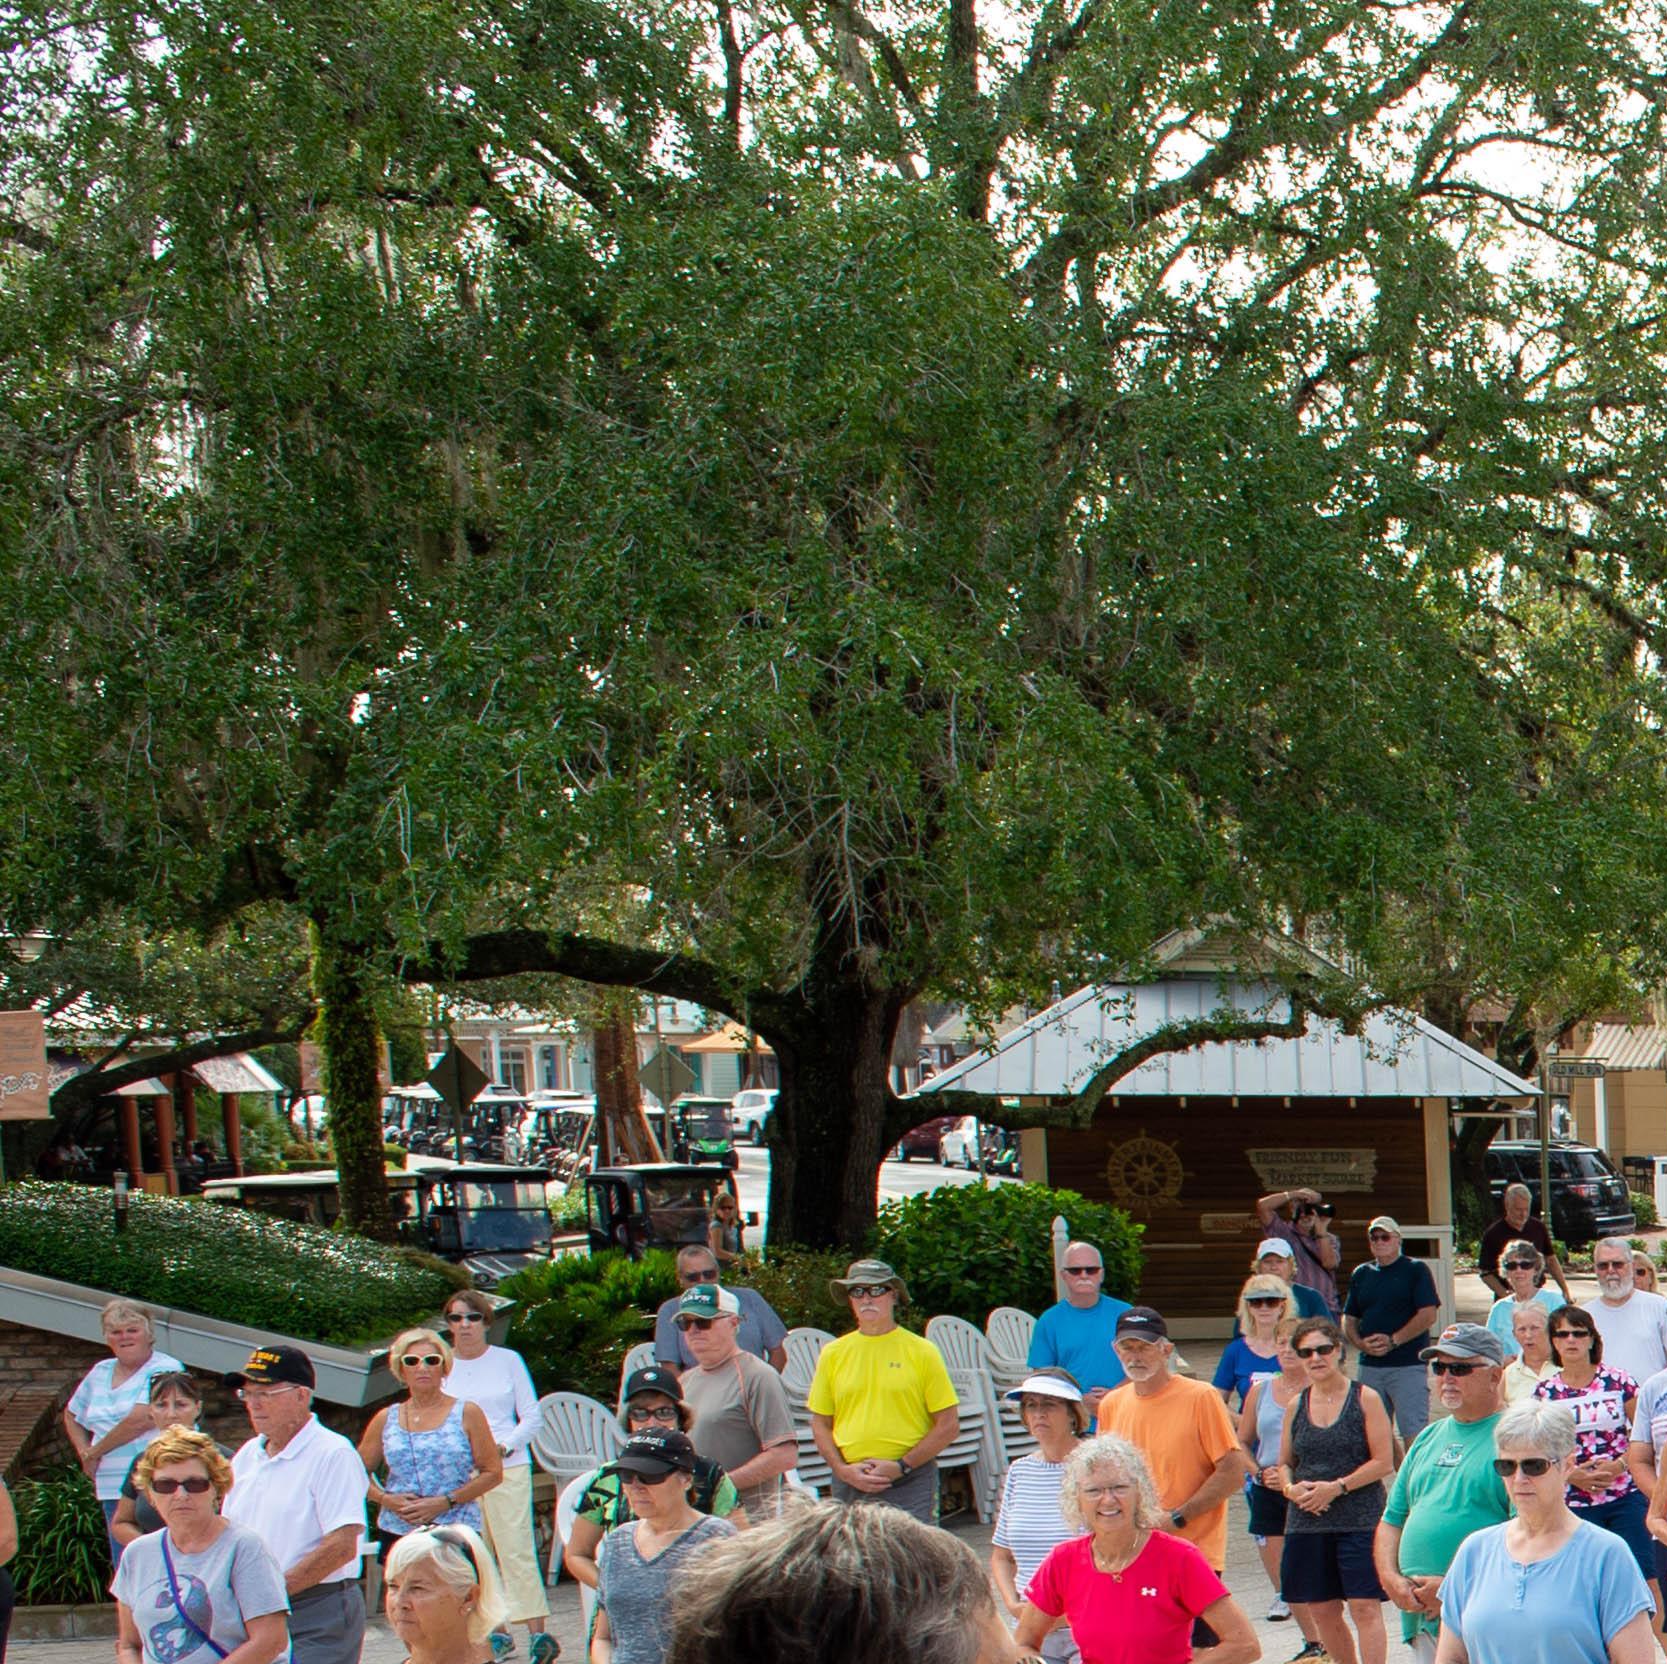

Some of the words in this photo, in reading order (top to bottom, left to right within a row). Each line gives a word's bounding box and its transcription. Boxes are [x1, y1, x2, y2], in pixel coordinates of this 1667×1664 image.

[1552, 1065, 1567, 1075] OLD
[1568, 1065, 1585, 1075] MILL
[1256, 1152, 1318, 1164] FRIENDLY
[1320, 1151, 1352, 1163] FUN
[1268, 1168, 1320, 1185] MARKET
